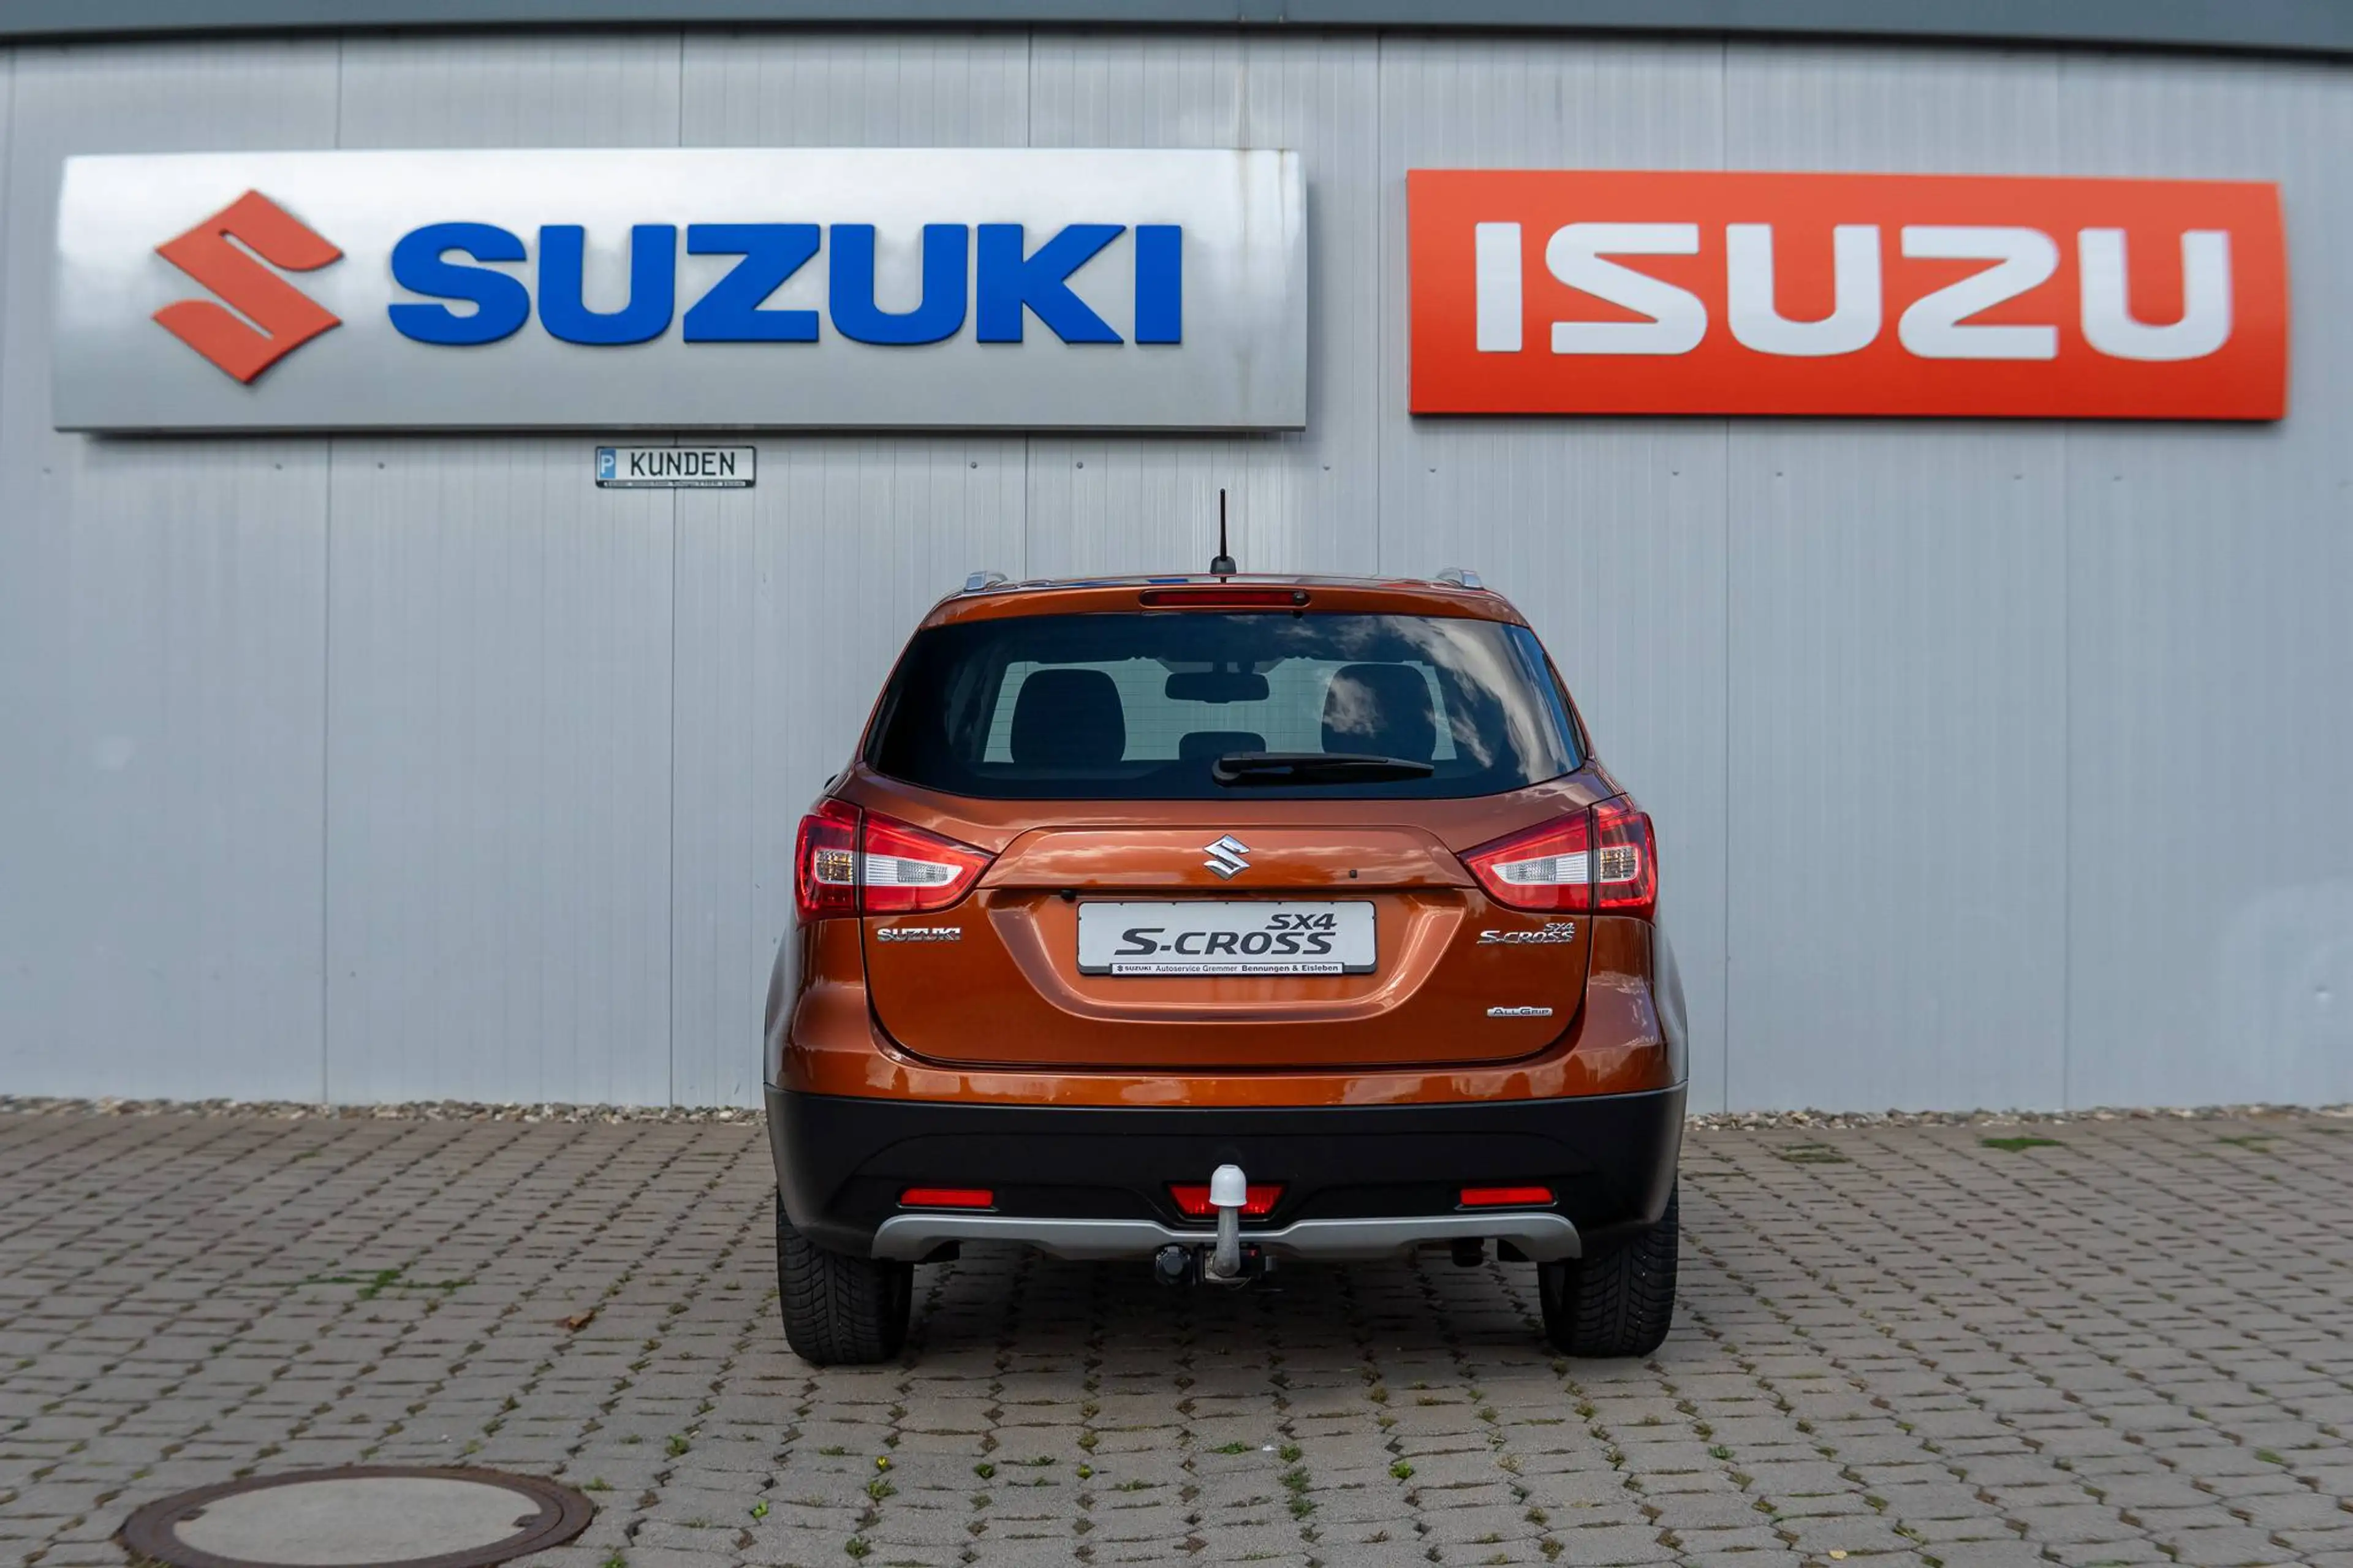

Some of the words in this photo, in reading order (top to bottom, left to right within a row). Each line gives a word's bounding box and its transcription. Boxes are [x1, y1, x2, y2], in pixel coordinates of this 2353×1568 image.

[388, 222, 1182, 346] SUZUKI
[1475, 221, 2231, 362] ISUZU
[601, 455, 613, 474] P
[631, 452, 735, 476] KUNDEN
[1265, 913, 1338, 930] SX4
[877, 928, 961, 942] SUZUKI
[1114, 928, 1336, 955] S-CROSS
